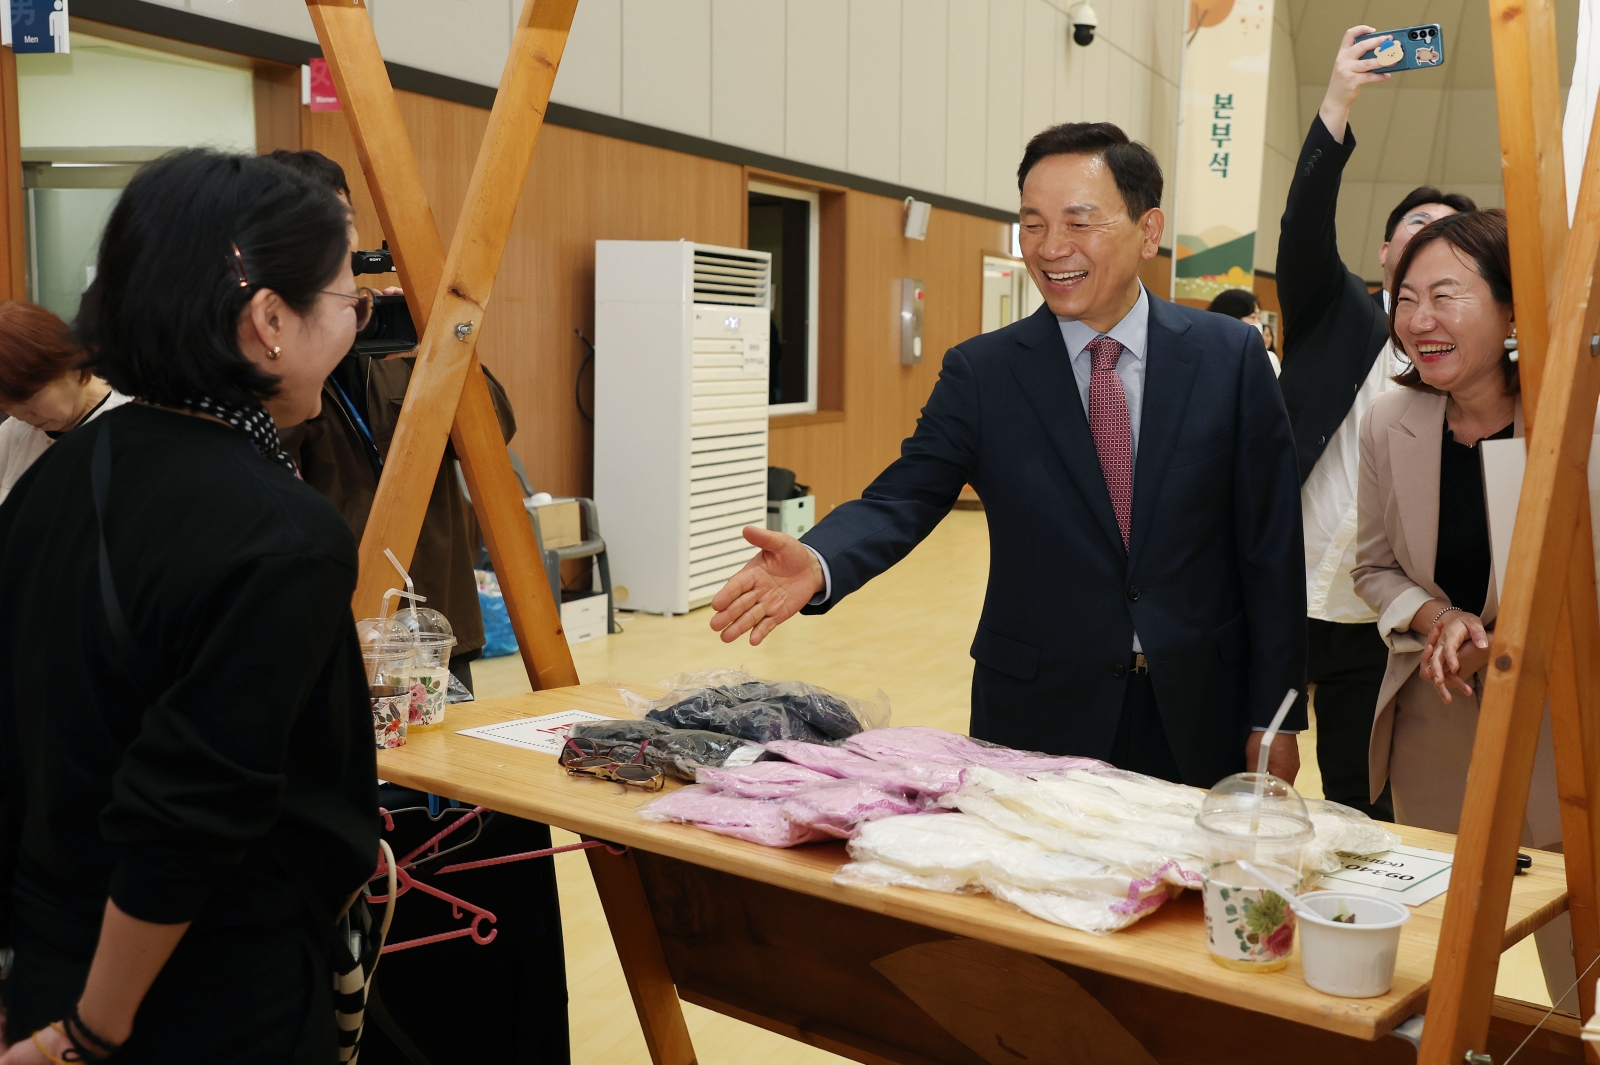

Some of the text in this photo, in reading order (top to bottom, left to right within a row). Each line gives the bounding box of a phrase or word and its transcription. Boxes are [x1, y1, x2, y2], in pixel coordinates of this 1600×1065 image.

[24, 35, 39, 43] Men
[1209, 93, 1234, 178] 본부석
[1340, 862, 1415, 881] 09340
